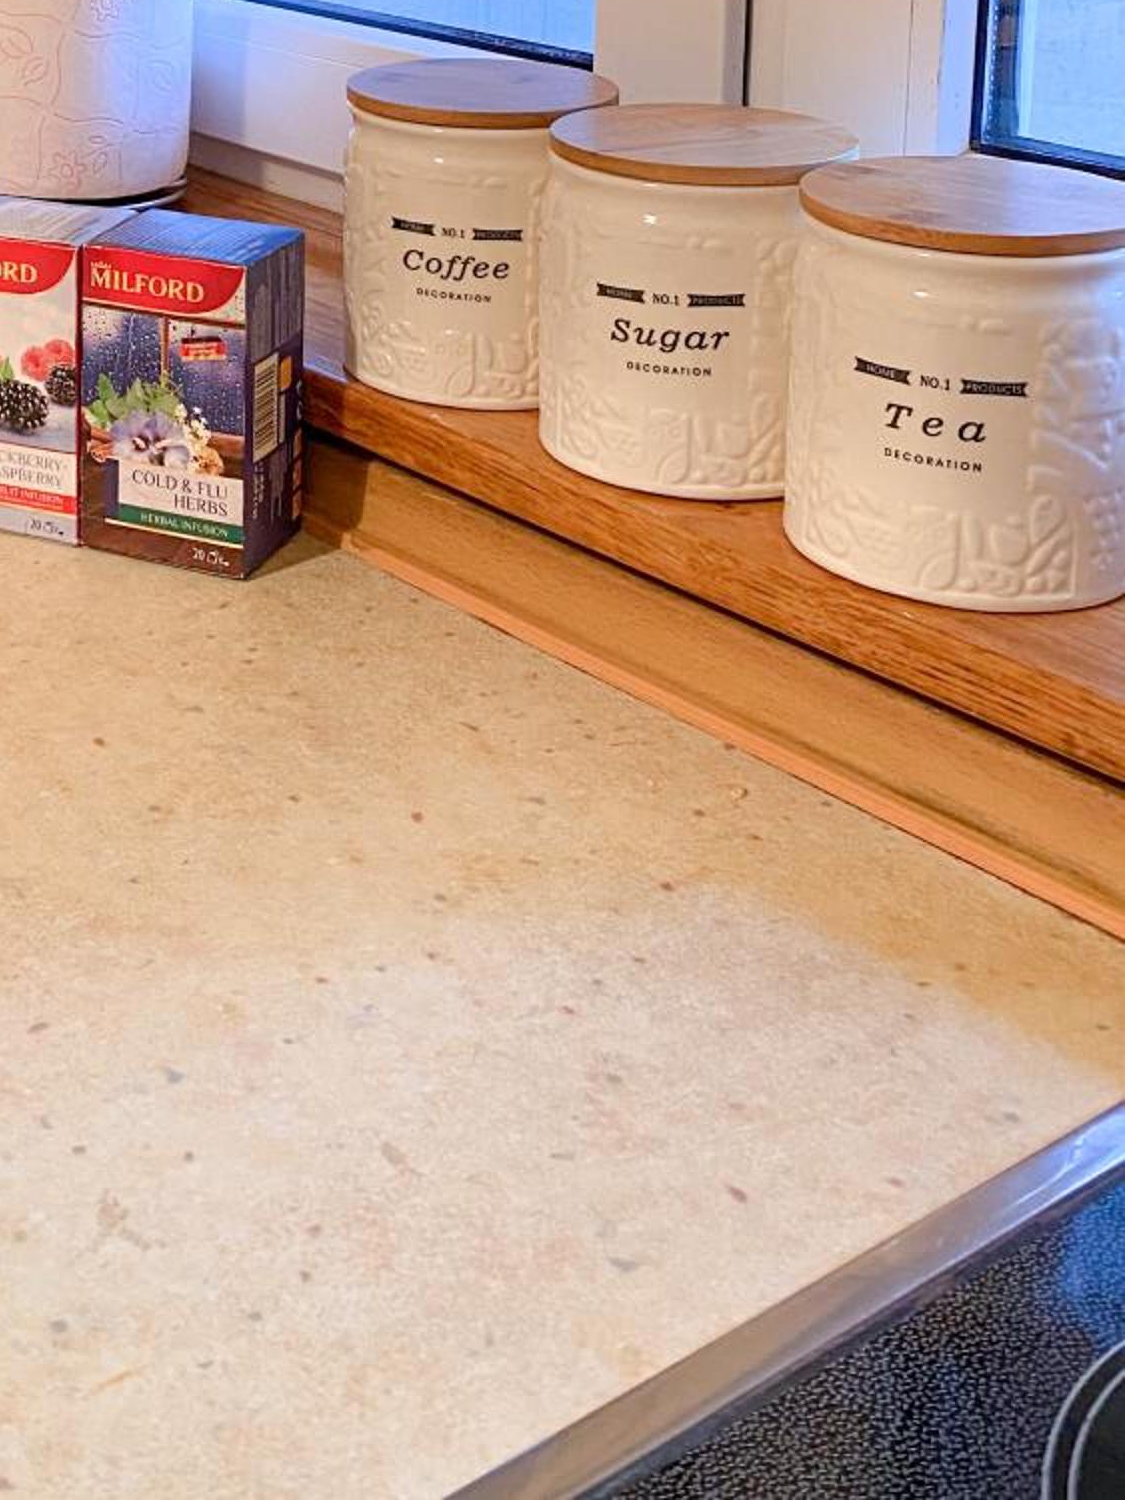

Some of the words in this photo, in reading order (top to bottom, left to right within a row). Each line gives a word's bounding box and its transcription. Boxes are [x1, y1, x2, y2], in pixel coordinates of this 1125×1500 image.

[441, 227, 466, 239] NO.1
[402, 249, 511, 282] Coffee
[90, 263, 205, 304] MILFORD
[415, 287, 493, 303] DECORATION
[652, 293, 680, 306] NO.1
[610, 318, 731, 353] Sugar
[625, 361, 713, 377] DECORATION
[866, 363, 897, 378] HOME
[919, 375, 951, 391] NO.1
[965, 384, 1023, 395] PRODUCTS
[884, 403, 987, 443] Tea
[883, 447, 983, 473] DECORATION
[131, 469, 178, 491] COLD
[181, 478, 193, 494] &
[197, 480, 229, 499] FLU
[174, 494, 229, 518] HERBS
[140, 512, 178, 530] HERBAL
[180, 520, 229, 538] INFUSION
